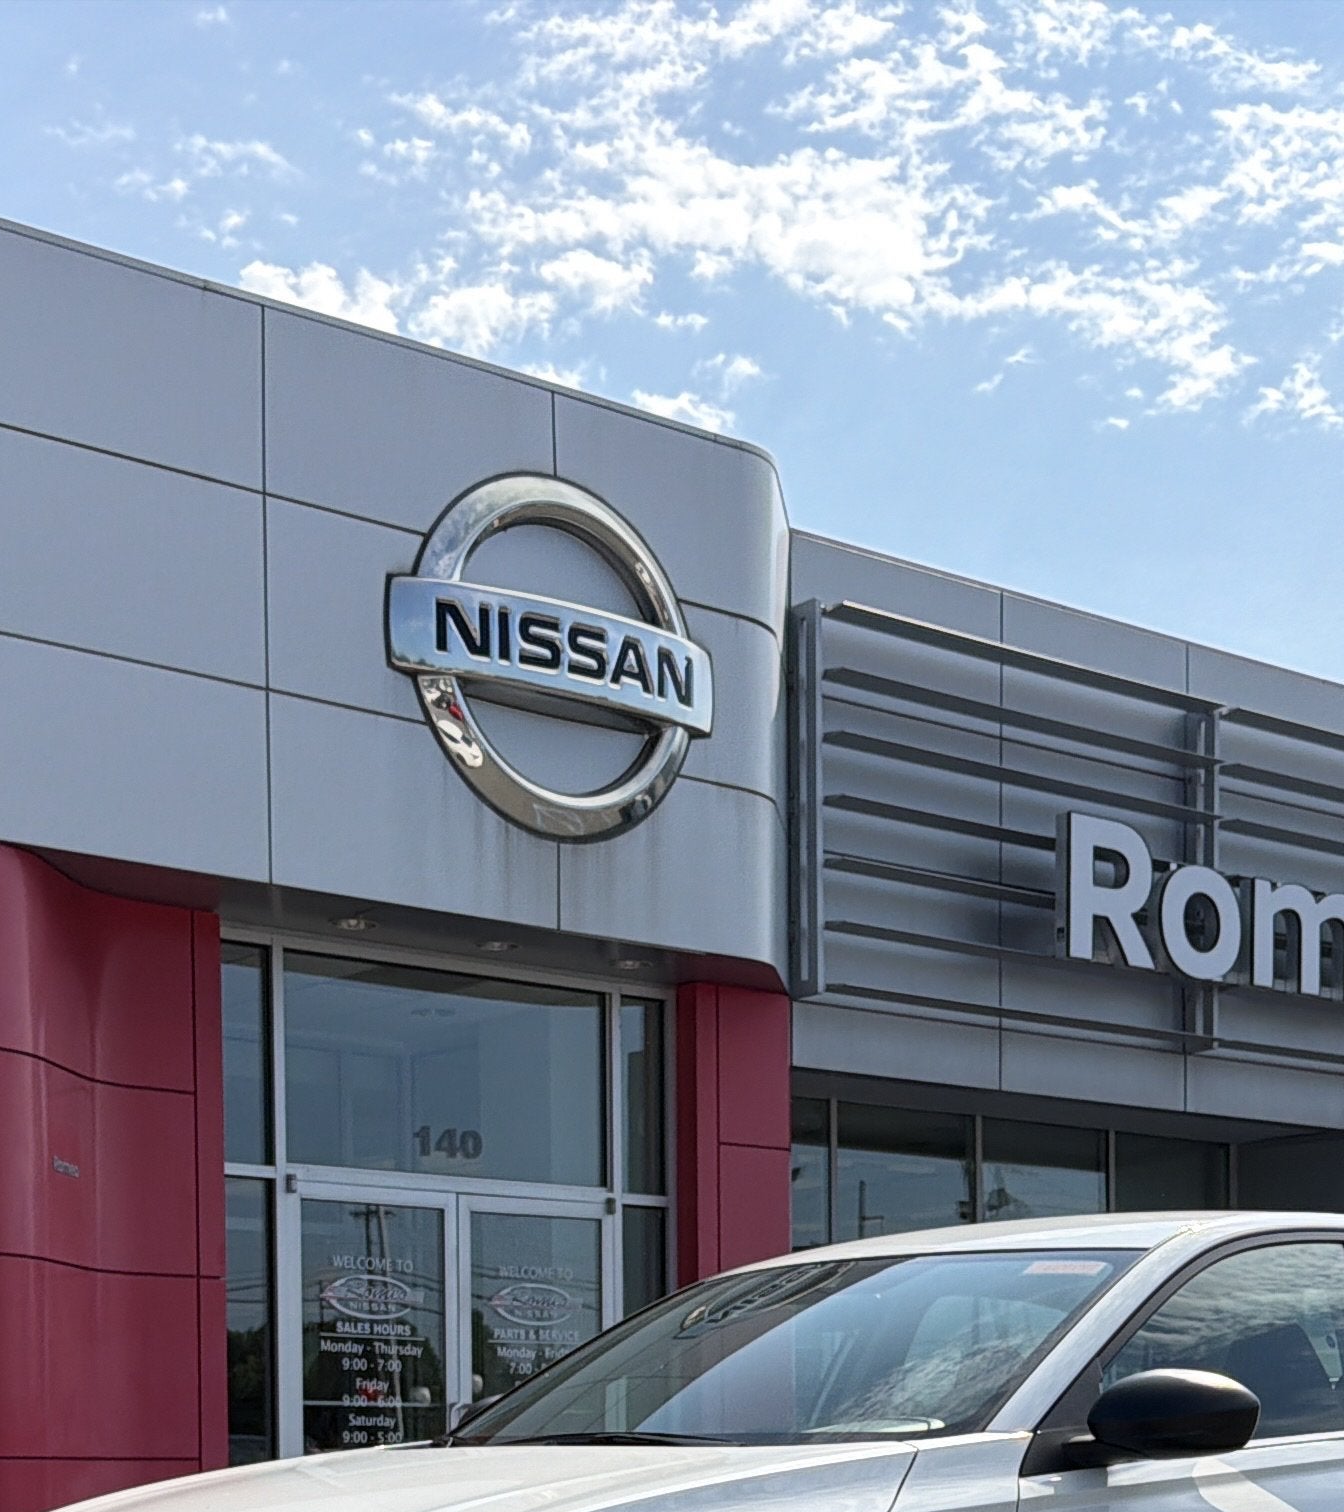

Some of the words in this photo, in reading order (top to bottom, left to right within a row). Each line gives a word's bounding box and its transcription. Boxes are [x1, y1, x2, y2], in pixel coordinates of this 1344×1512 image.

[434, 597, 695, 711] NISSAN
[413, 1125, 483, 1159] 140
[332, 1254, 393, 1272] WELCOME
[397, 1260, 414, 1273] TO
[498, 1264, 556, 1280] WELCOME
[559, 1266, 574, 1280] TO
[349, 1301, 397, 1312] NISSAN
[336, 1321, 371, 1335] SALES
[373, 1323, 412, 1337] HOURS
[493, 1328, 524, 1340] PARTS
[529, 1330, 536, 1341] &
[538, 1329, 579, 1342] SERVICE
[320, 1340, 365, 1355] Monday
[373, 1342, 424, 1358] Thursday
[497, 1346, 537, 1360] Monday
[341, 1358, 368, 1371] 9:00
[377, 1359, 403, 1372] 7:00
[509, 1362, 533, 1375] 7:00
[355, 1377, 390, 1393] Friday
[341, 1394, 368, 1407] 9:00
[377, 1395, 403, 1408] 6:00
[348, 1413, 397, 1429] Saturday
[342, 1431, 368, 1444] 9:00
[377, 1431, 403, 1444] 5:00
